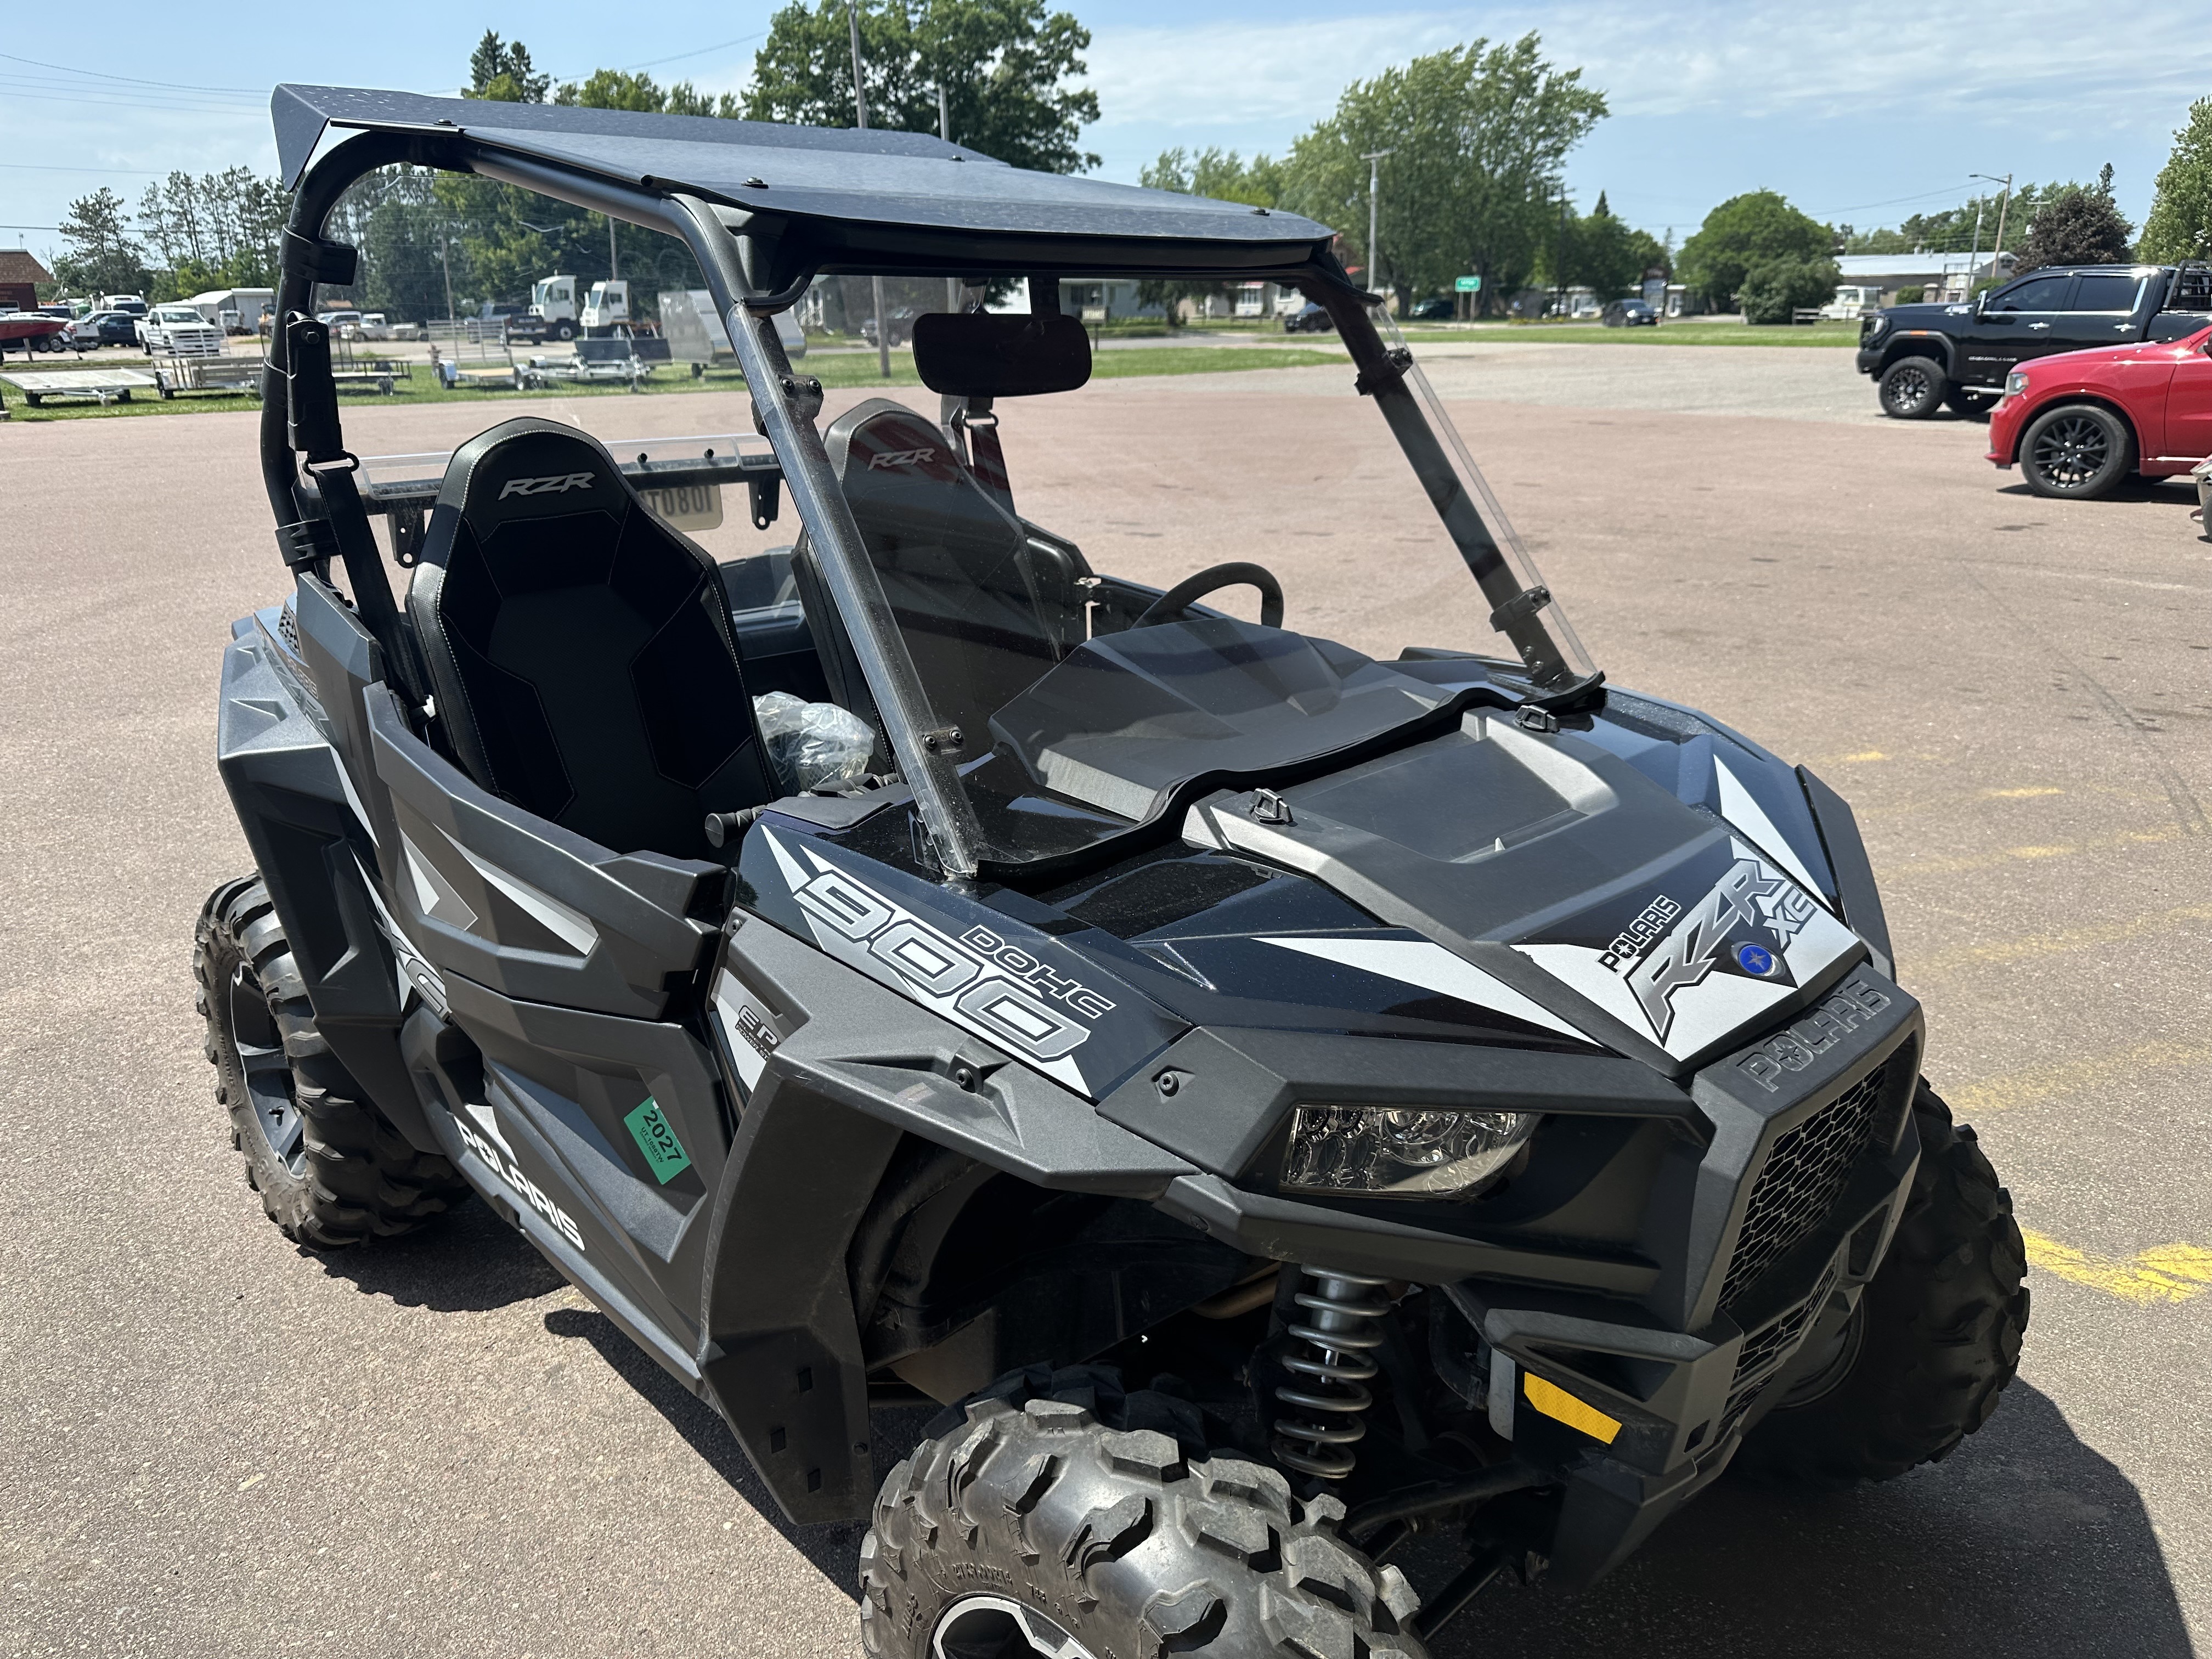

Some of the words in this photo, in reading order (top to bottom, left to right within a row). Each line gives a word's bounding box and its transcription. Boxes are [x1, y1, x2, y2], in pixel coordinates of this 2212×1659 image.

[498, 472, 596, 501] RZR
[867, 447, 935, 472] RZR
[1594, 894, 1682, 975] POLARIS
[1624, 857, 1786, 1049] RZR
[1762, 884, 1818, 953] XC
[794, 870, 1091, 1063] 900
[959, 924, 1118, 1019] DOHC
[735, 1024, 759, 1050] POWER
[1736, 979, 1892, 1093] POLARIS
[641, 1126, 649, 1136] UT
[643, 1109, 682, 1160] 2027
[453, 1115, 585, 1251] POLARIS
